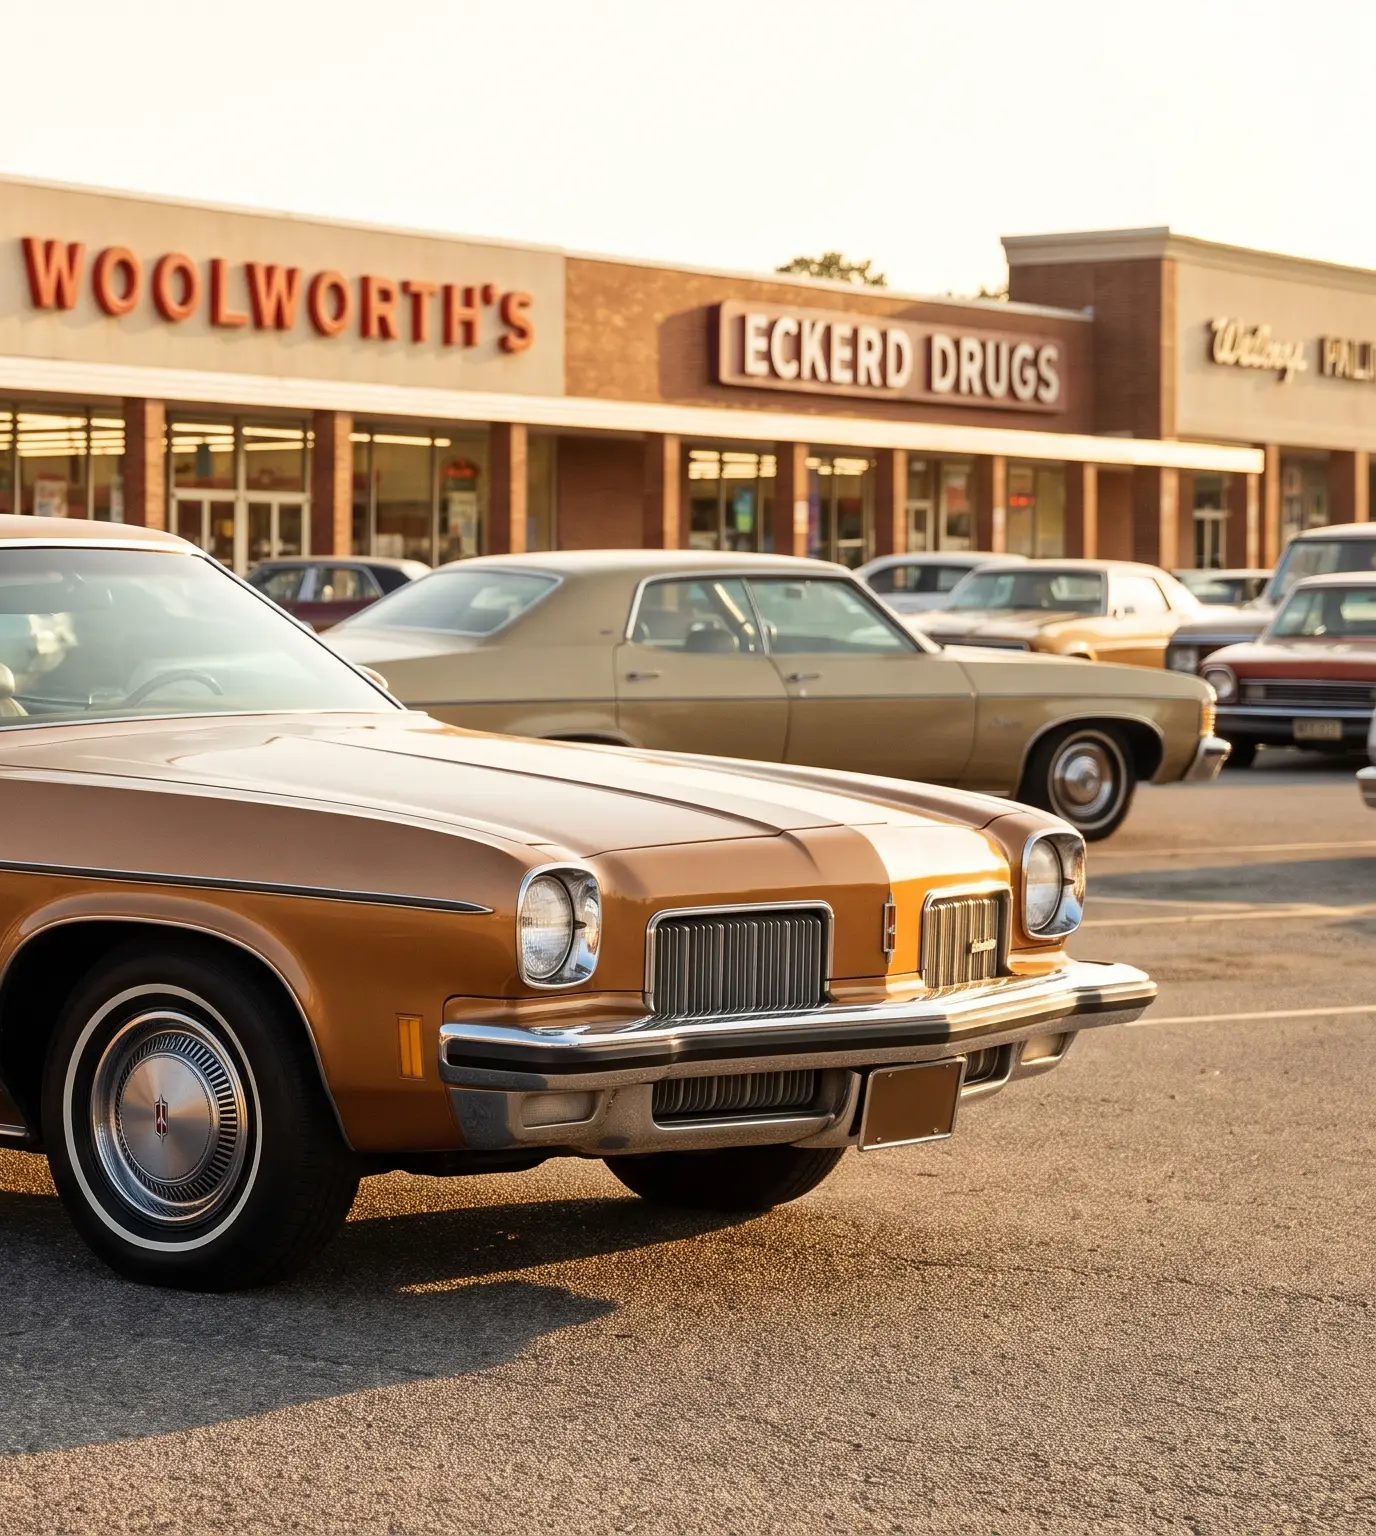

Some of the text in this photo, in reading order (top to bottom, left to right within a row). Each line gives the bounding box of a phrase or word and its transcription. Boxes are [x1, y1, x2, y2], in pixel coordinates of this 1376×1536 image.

[21, 236, 535, 353] WOOLWORTH'S
[743, 312, 1061, 404] ECKERD DRUGS
